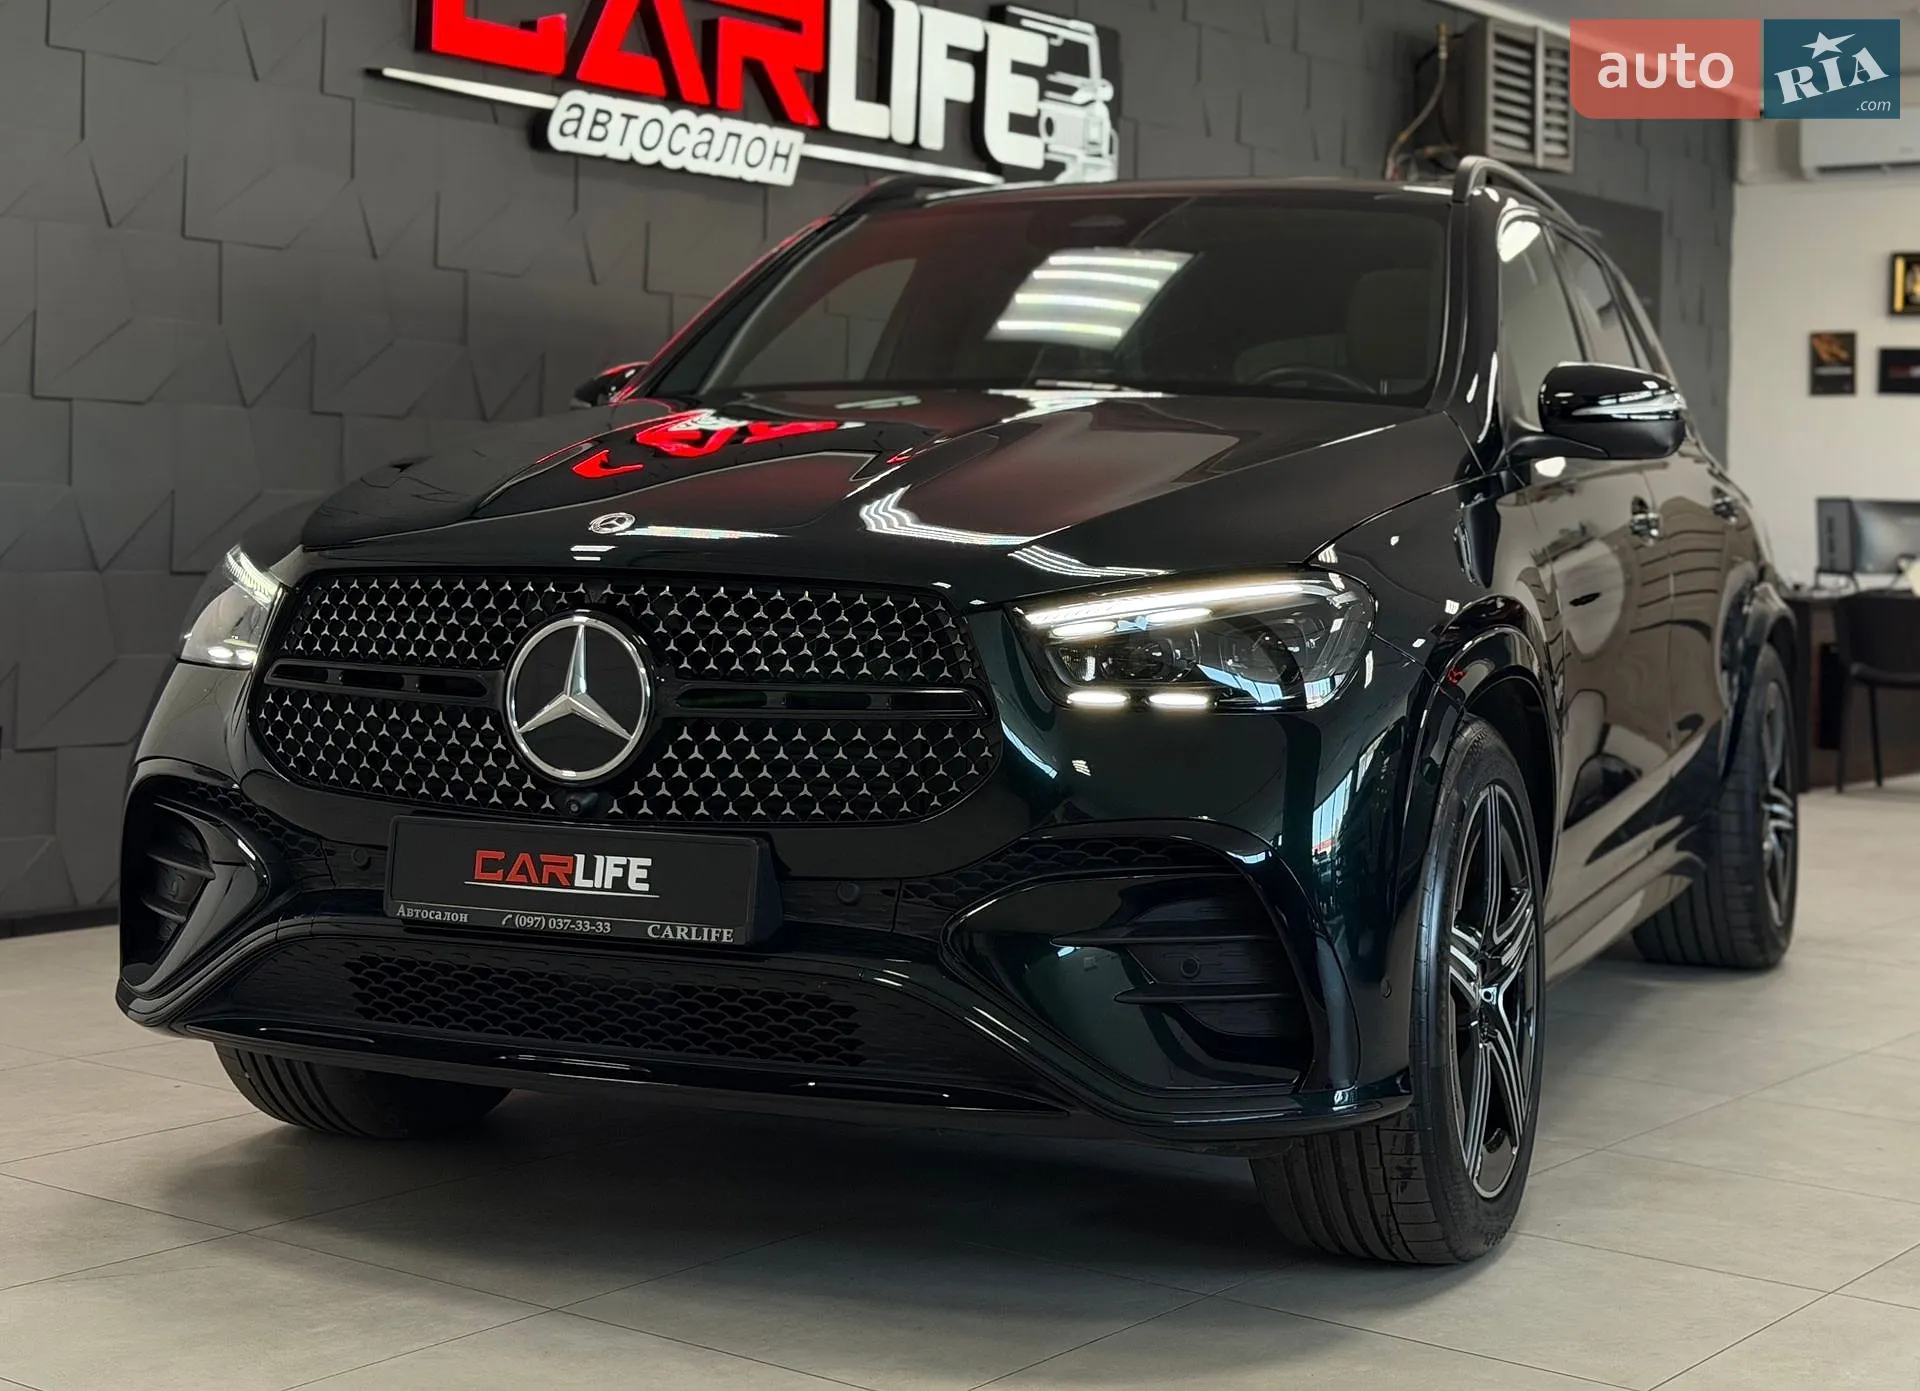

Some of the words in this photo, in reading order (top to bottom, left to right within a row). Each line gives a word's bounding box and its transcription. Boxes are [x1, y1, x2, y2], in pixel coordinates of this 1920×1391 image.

[558, 102, 795, 174] автосалон
[474, 849, 652, 892] CARLIFE
[396, 904, 469, 923] Автосалон
[514, 914, 546, 929] (097)
[548, 917, 611, 933] 037-33-33
[646, 924, 734, 943] CARLIFE
